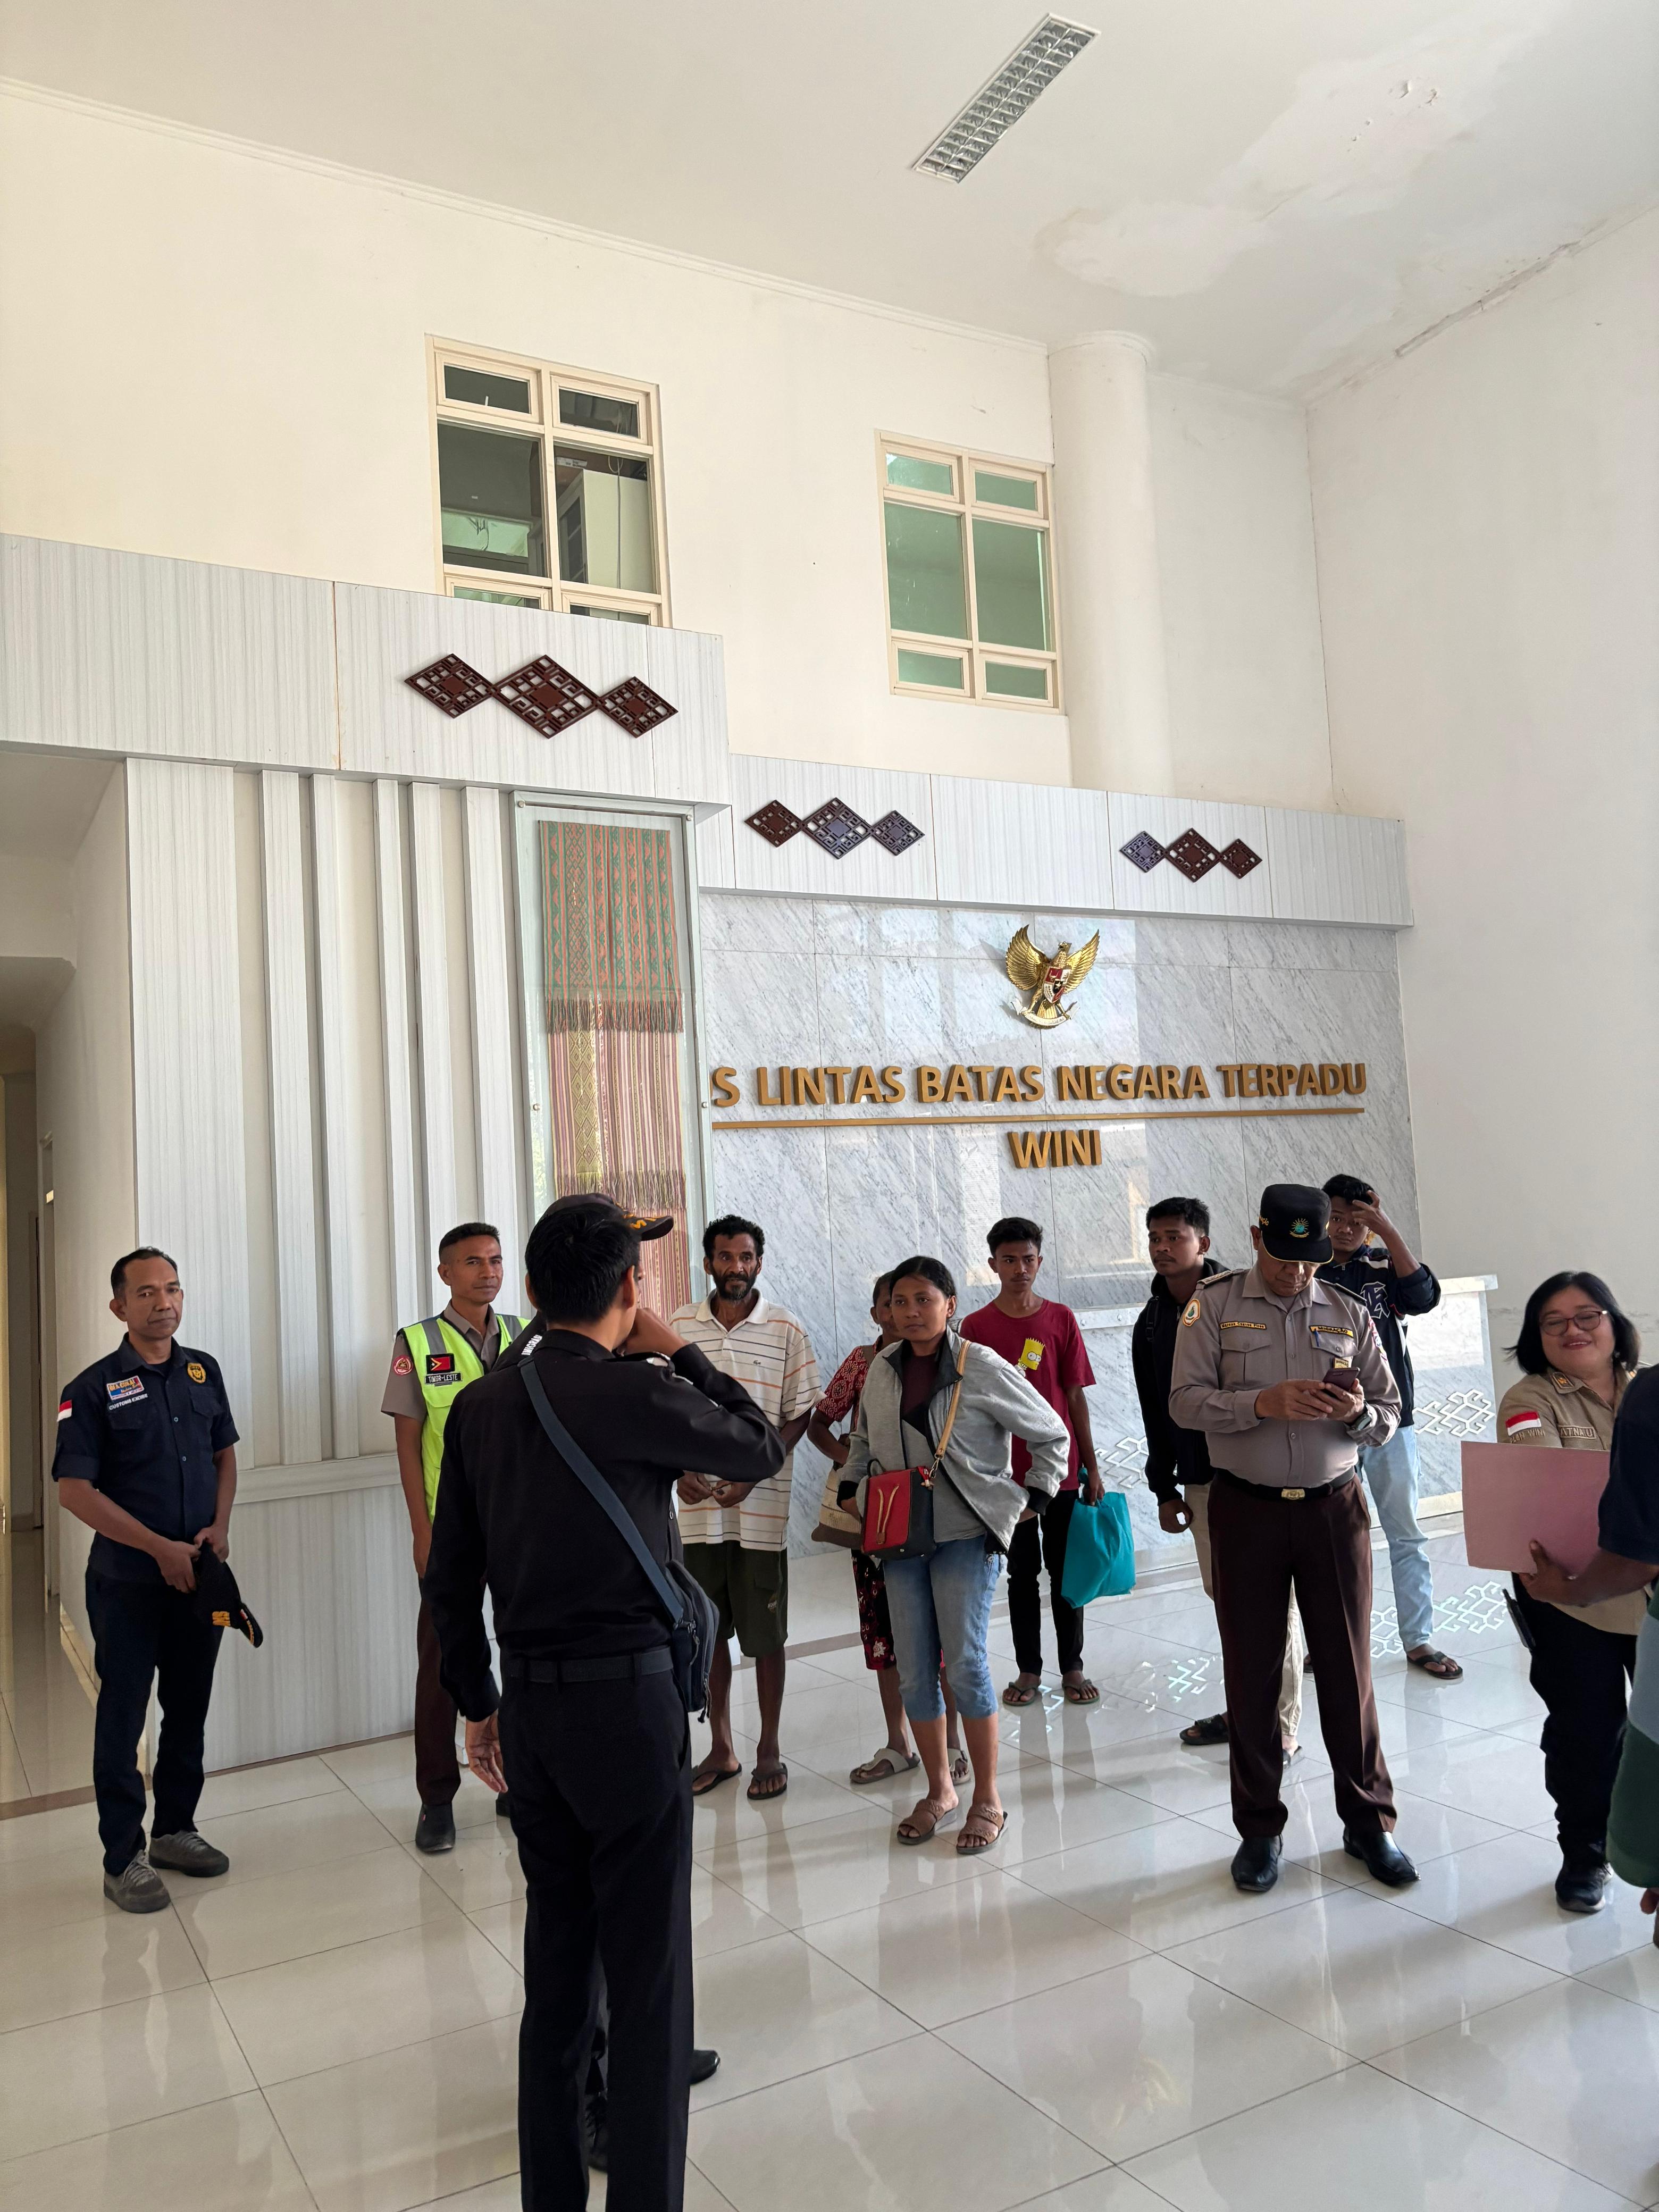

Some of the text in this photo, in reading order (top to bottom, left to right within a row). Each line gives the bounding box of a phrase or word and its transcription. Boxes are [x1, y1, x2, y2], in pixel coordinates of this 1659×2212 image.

[709, 1063, 1367, 1107] S LINTAS BATAS NEGARA TERPADU
[1007, 1129, 1102, 1168] WINI
[428, 1373, 458, 1383] TIMOR-LESTE
